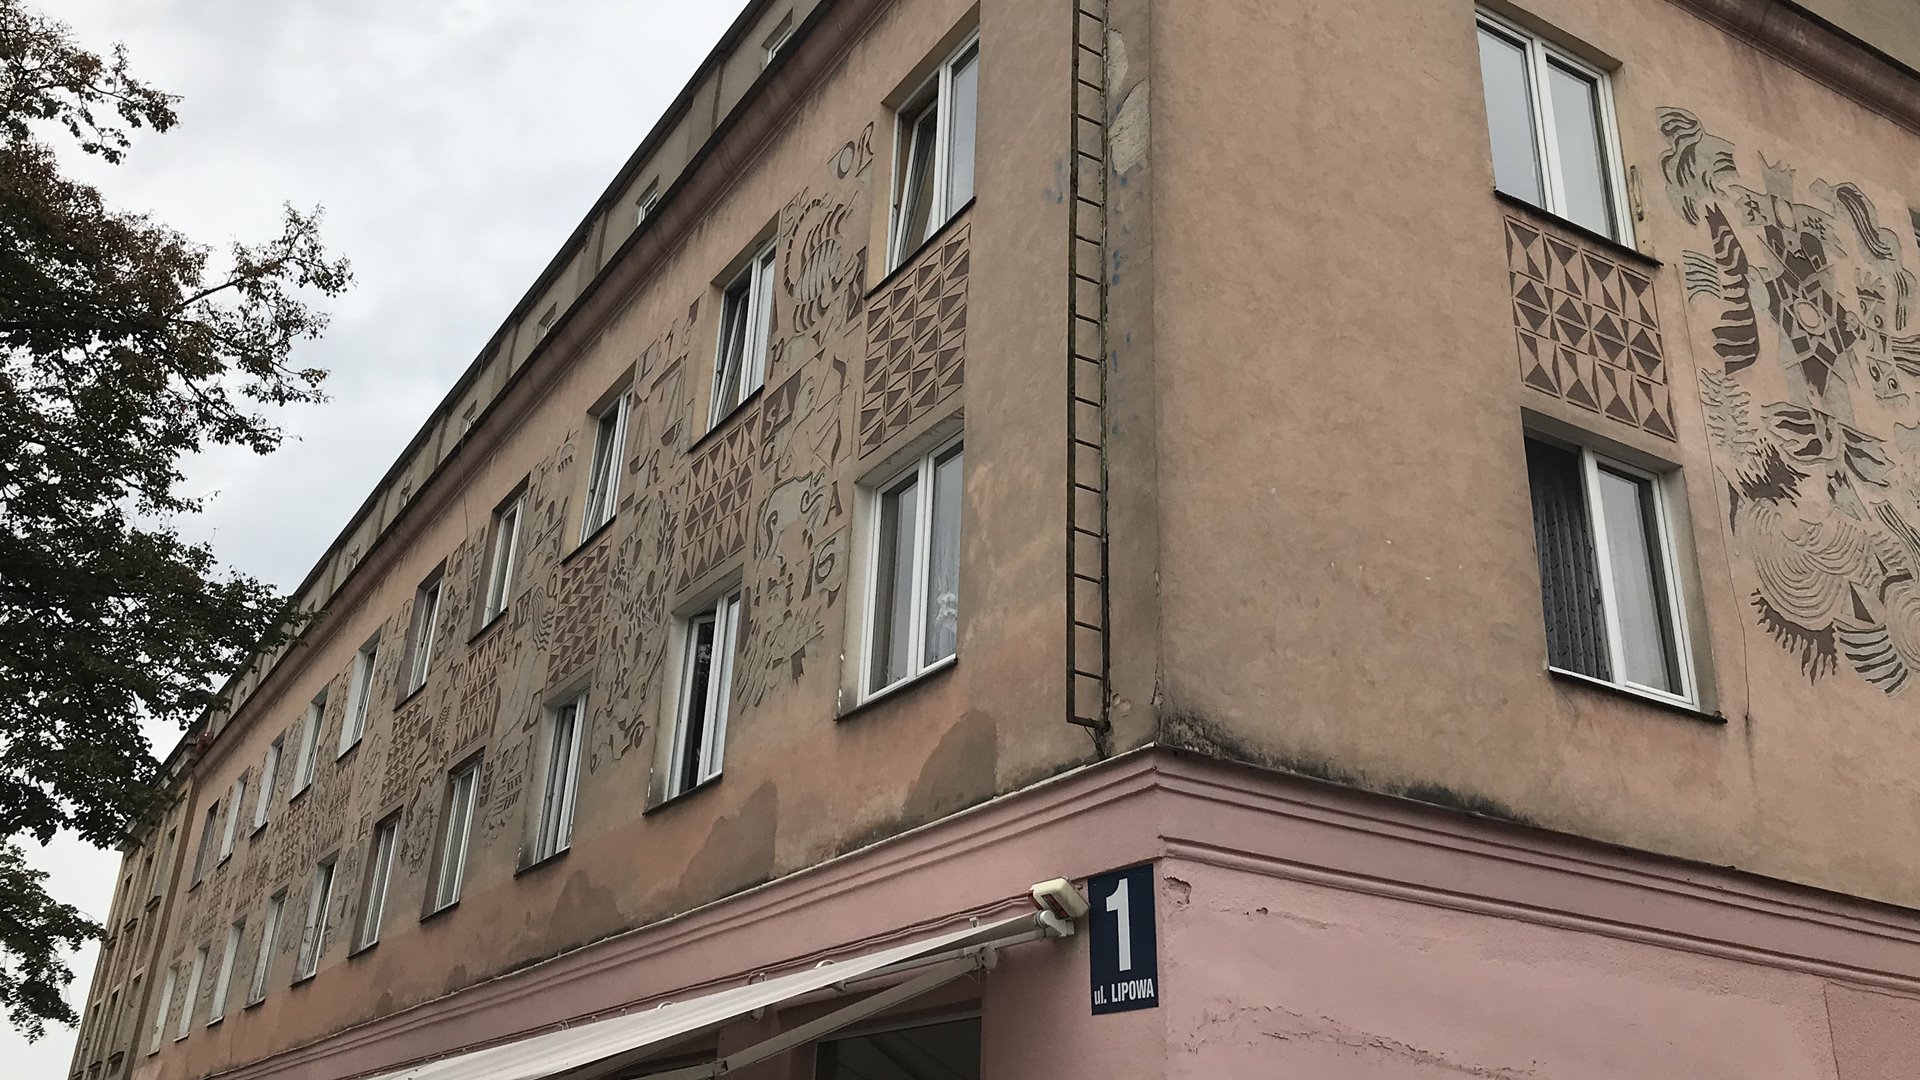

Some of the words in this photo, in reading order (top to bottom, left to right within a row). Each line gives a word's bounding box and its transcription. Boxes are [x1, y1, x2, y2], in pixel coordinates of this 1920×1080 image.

[1105, 877, 1132, 972] 1
[1094, 985, 1107, 1006] ul.
[1111, 978, 1155, 1003] LIPOWA
